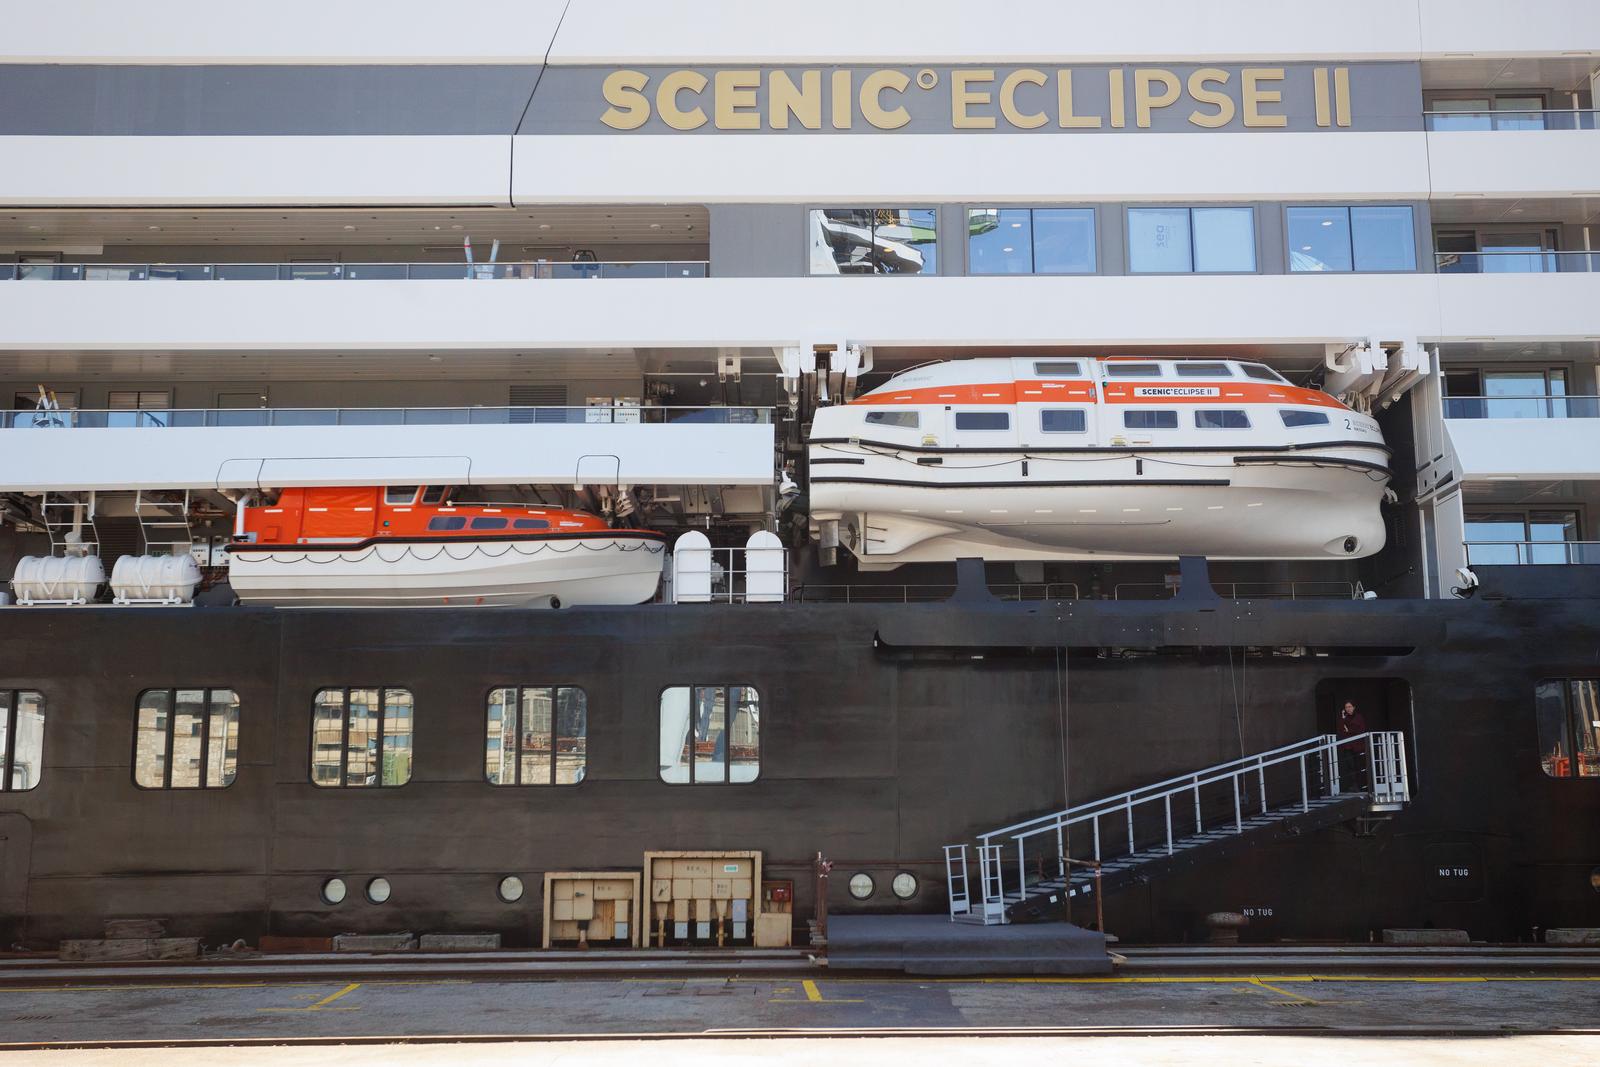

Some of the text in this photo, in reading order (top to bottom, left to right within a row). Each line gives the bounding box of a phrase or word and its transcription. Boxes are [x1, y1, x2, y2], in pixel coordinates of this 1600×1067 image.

[950, 68, 1289, 130] ECLIPSE
[1313, 67, 1352, 128] II
[1344, 418, 1351, 430] 2
[1439, 868, 1469, 876] NO TUG
[1243, 908, 1273, 917] NO TUG
